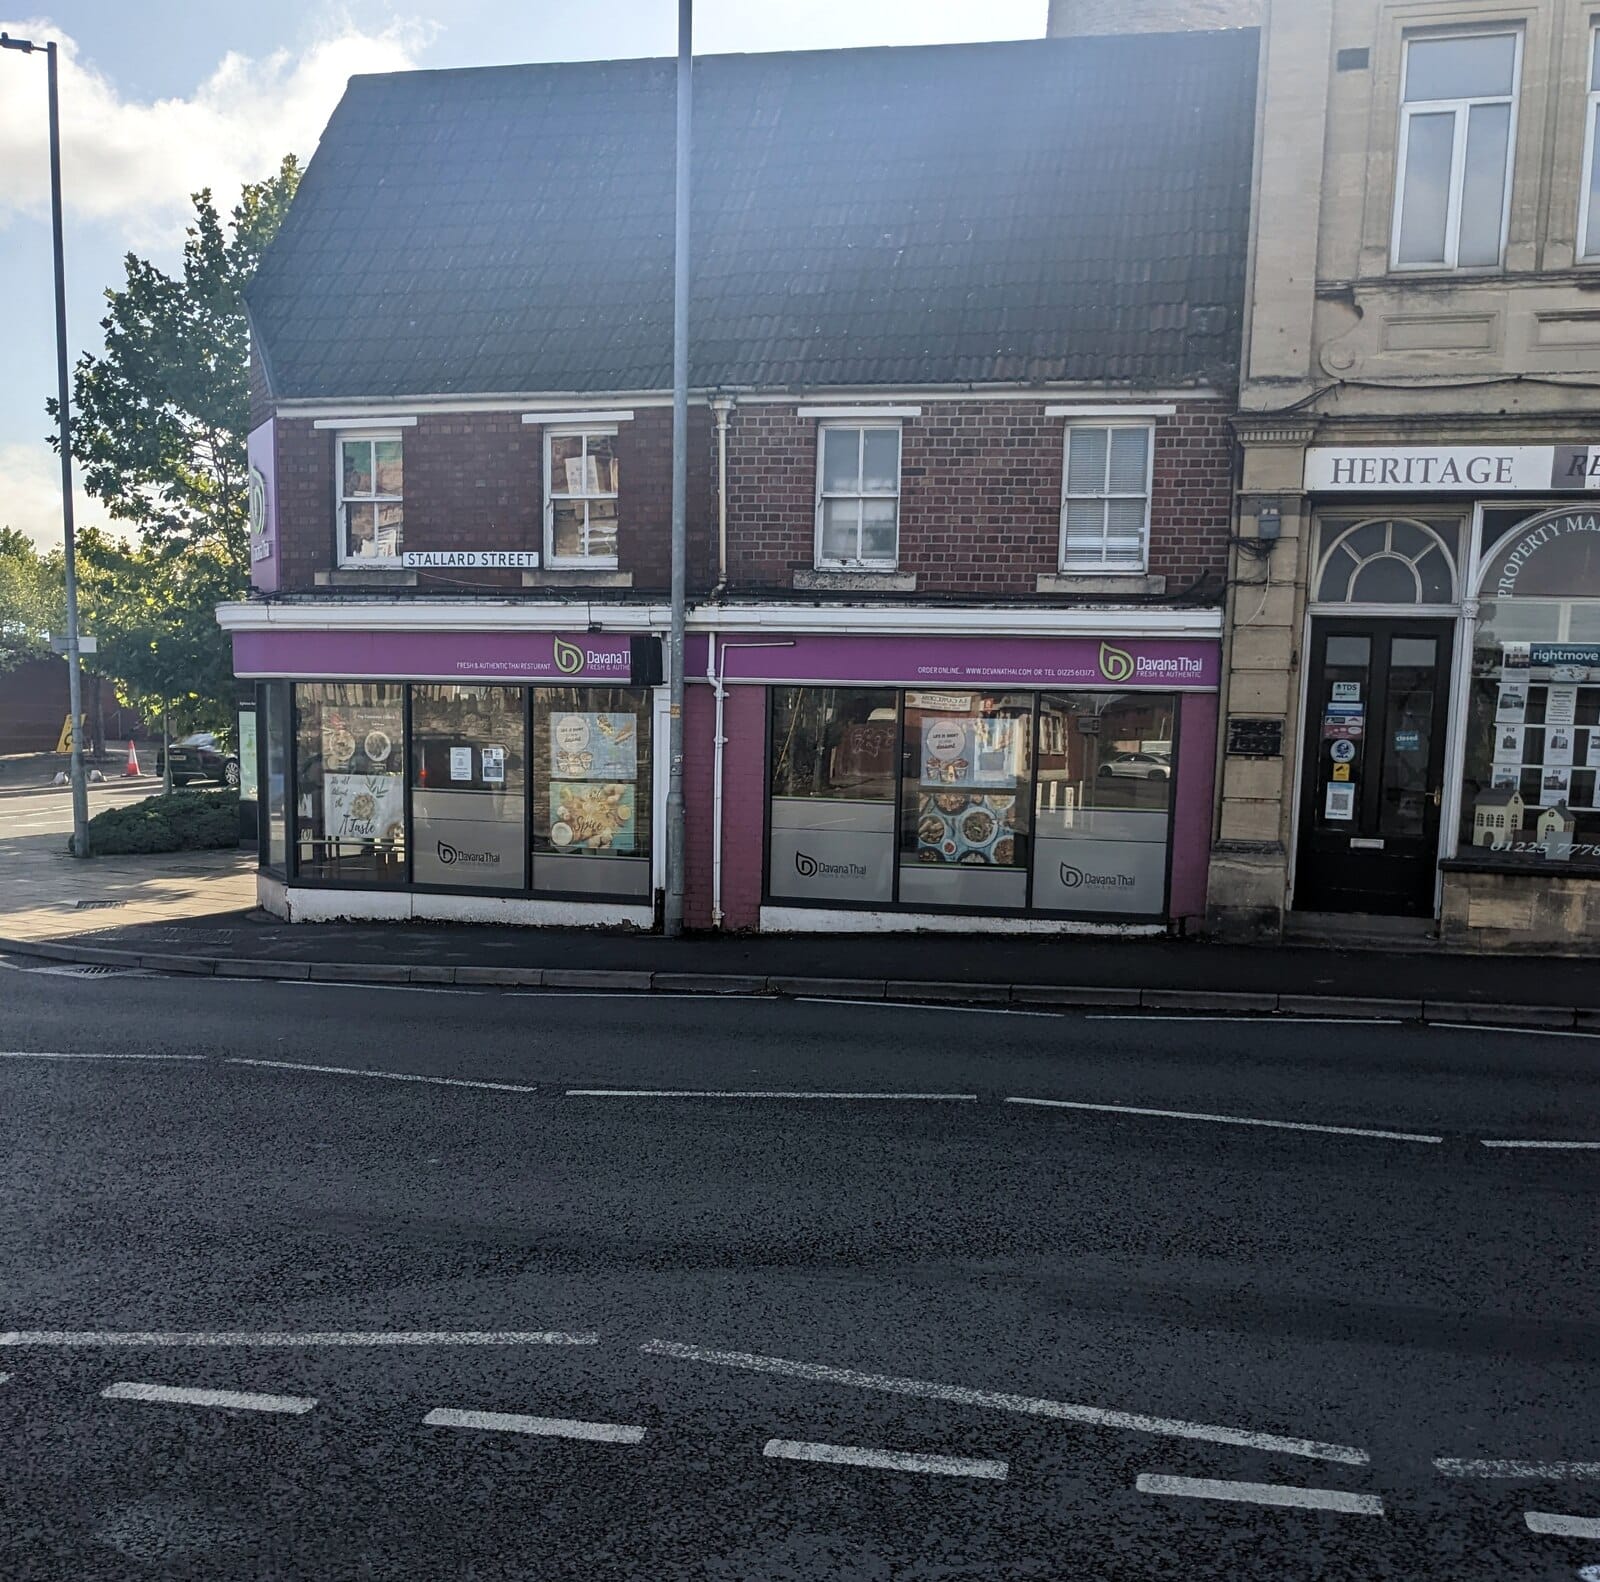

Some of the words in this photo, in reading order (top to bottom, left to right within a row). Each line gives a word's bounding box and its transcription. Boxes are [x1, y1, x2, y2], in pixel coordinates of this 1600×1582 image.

[1330, 456, 1514, 484] HERITAGE
[408, 553, 476, 566] STALLARD
[481, 553, 534, 566] STREET
[1497, 520, 1560, 599] PROPERTY
[1566, 515, 1600, 533] MA
[1490, 841, 1551, 854] 01225
